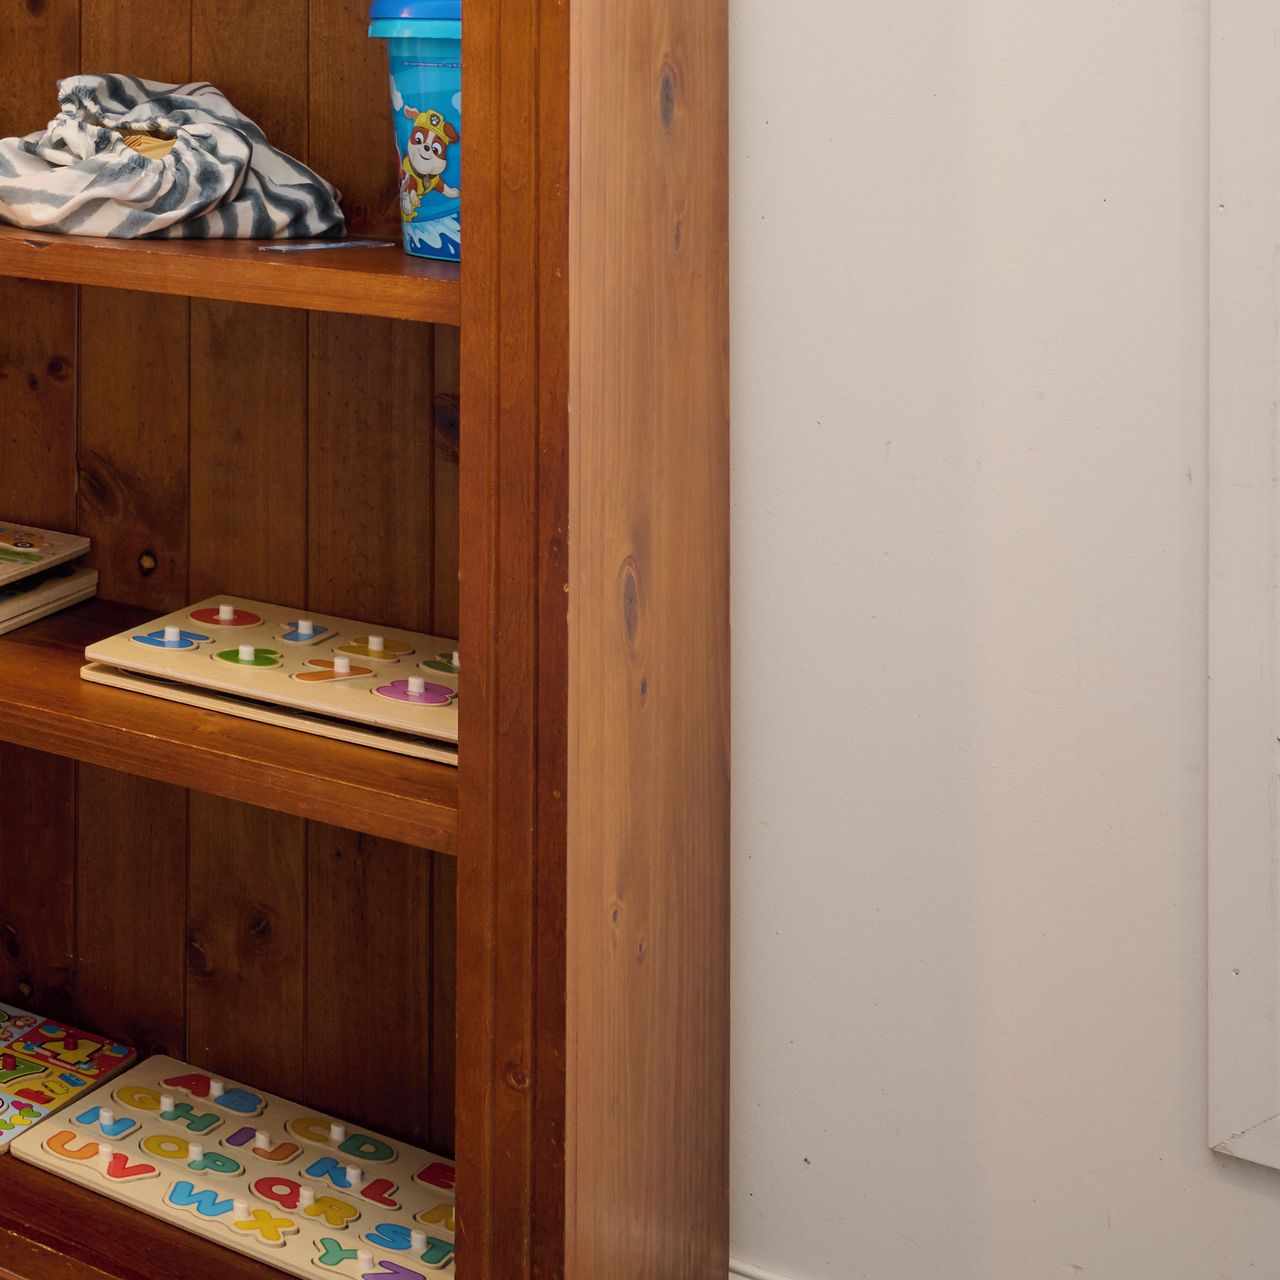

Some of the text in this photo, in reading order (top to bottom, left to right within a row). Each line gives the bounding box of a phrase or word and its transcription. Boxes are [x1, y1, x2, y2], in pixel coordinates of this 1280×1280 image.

[337, 1133, 394, 1161] D
[46, 1130, 100, 1160] U
[106, 1152, 156, 1179] V
[168, 1180, 236, 1217] W
[234, 1208, 296, 1241] X
[318, 1237, 359, 1266] Y
[254, 1177, 303, 1210] Q
[303, 1195, 360, 1227] R
[365, 1223, 413, 1251] S
[360, 1178, 399, 1207] L
